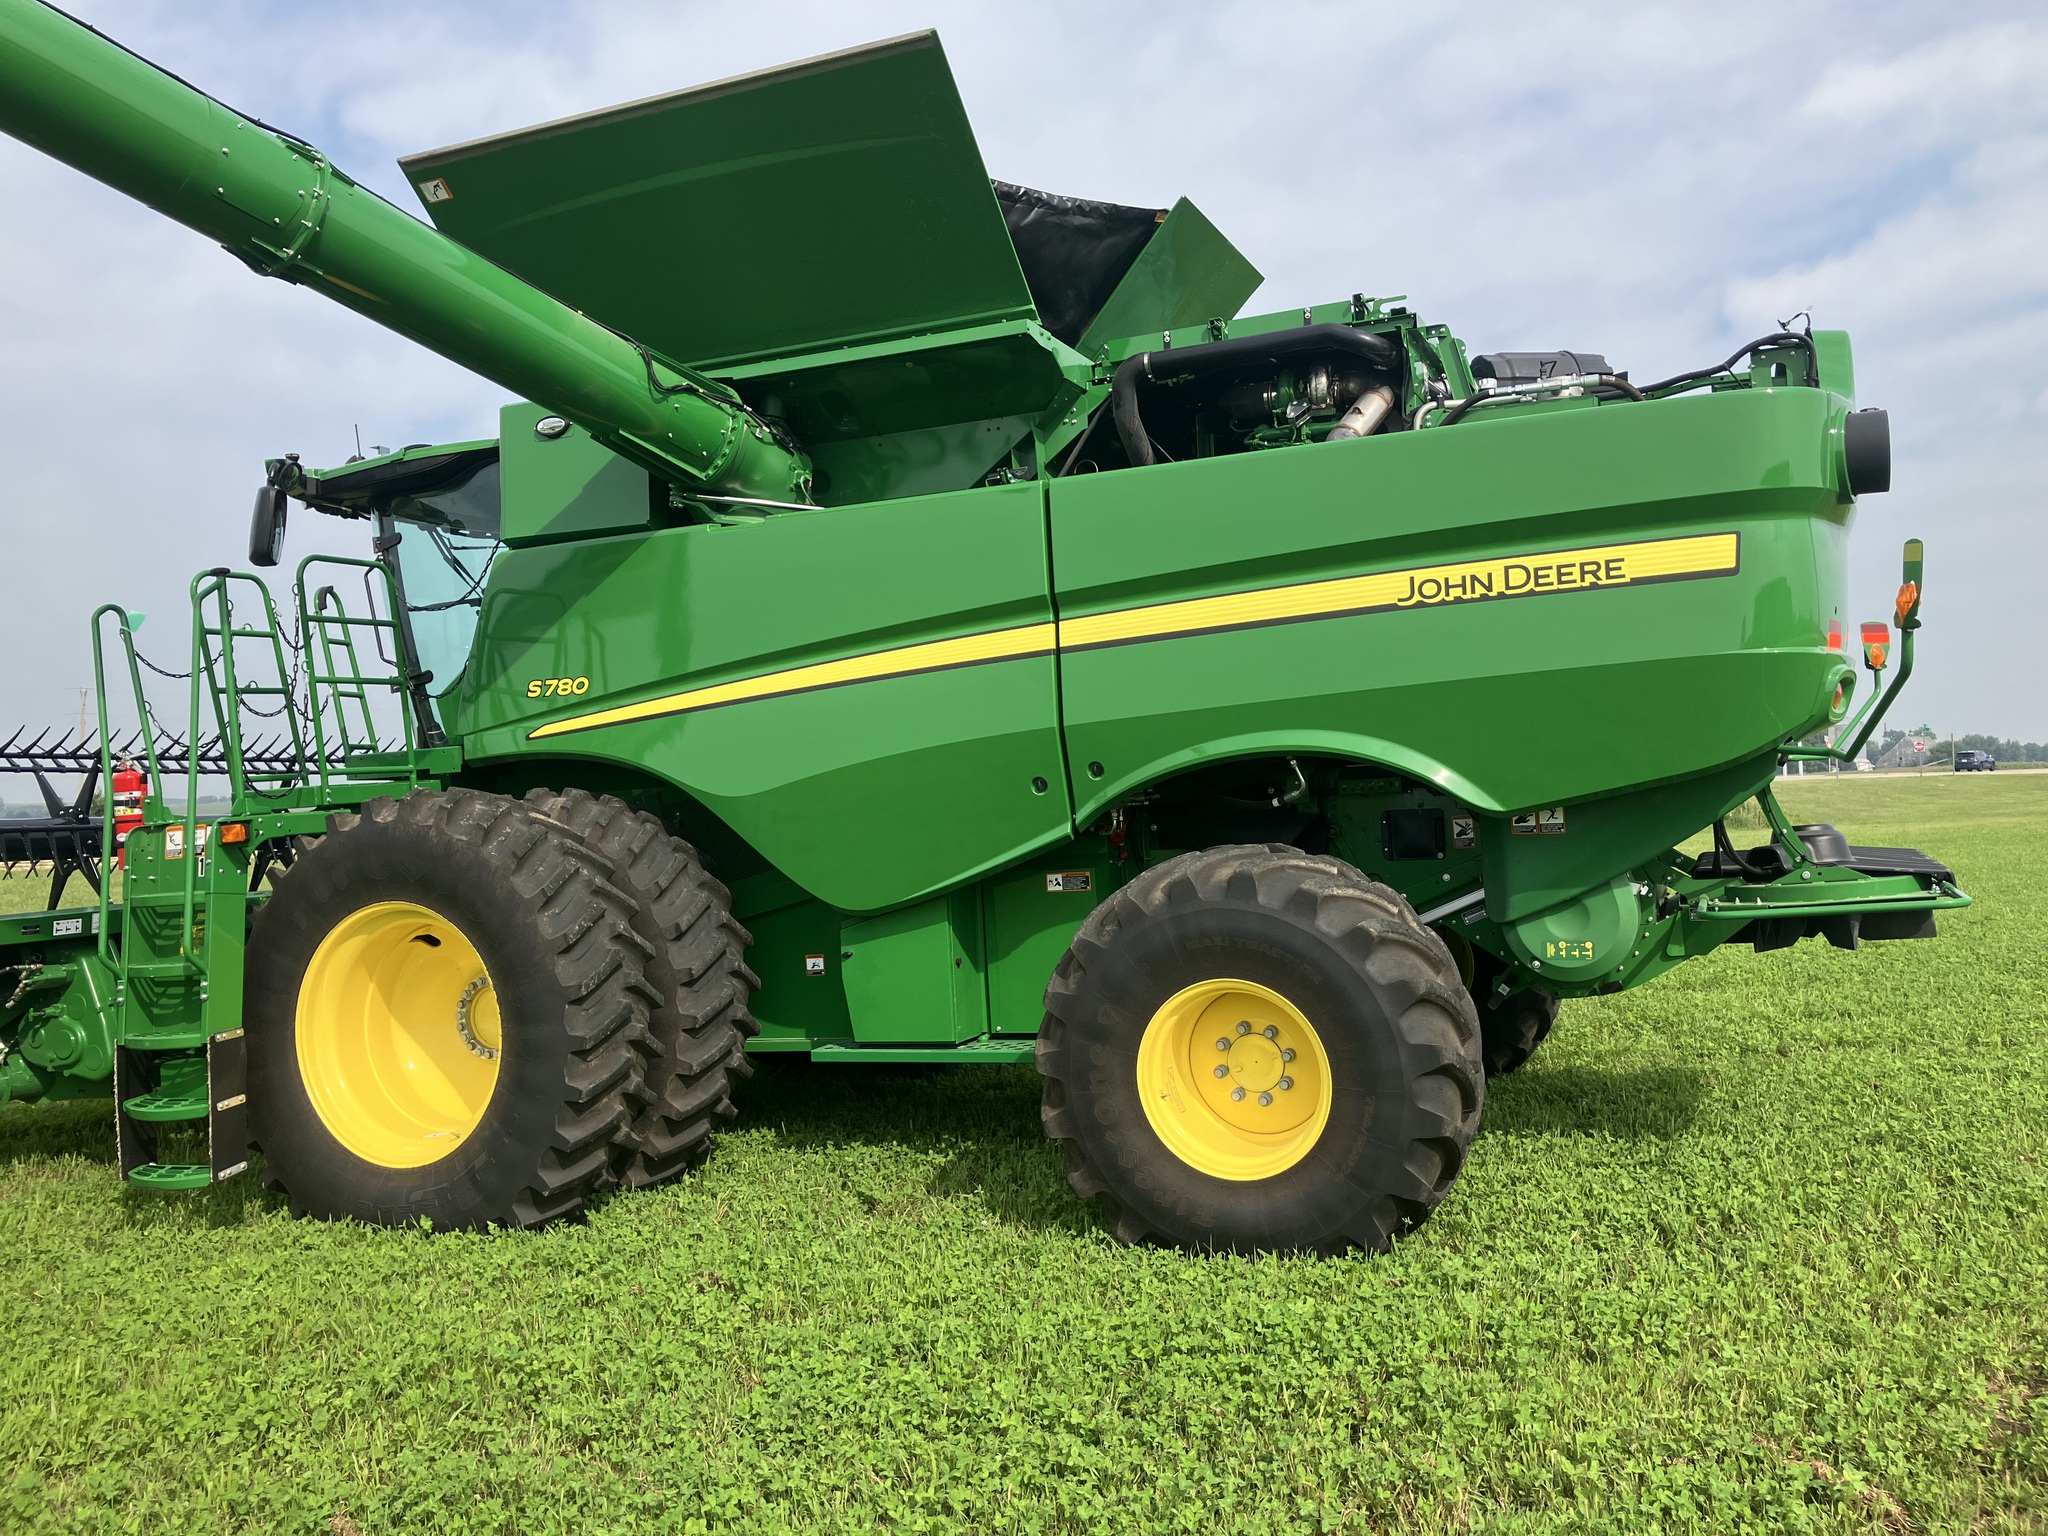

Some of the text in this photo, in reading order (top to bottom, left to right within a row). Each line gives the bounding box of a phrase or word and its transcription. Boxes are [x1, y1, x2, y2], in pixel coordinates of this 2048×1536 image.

[1397, 557, 1626, 602] JOHN DEERE
[526, 676, 590, 699] S780
[1089, 1043, 1216, 1228] Firestone
